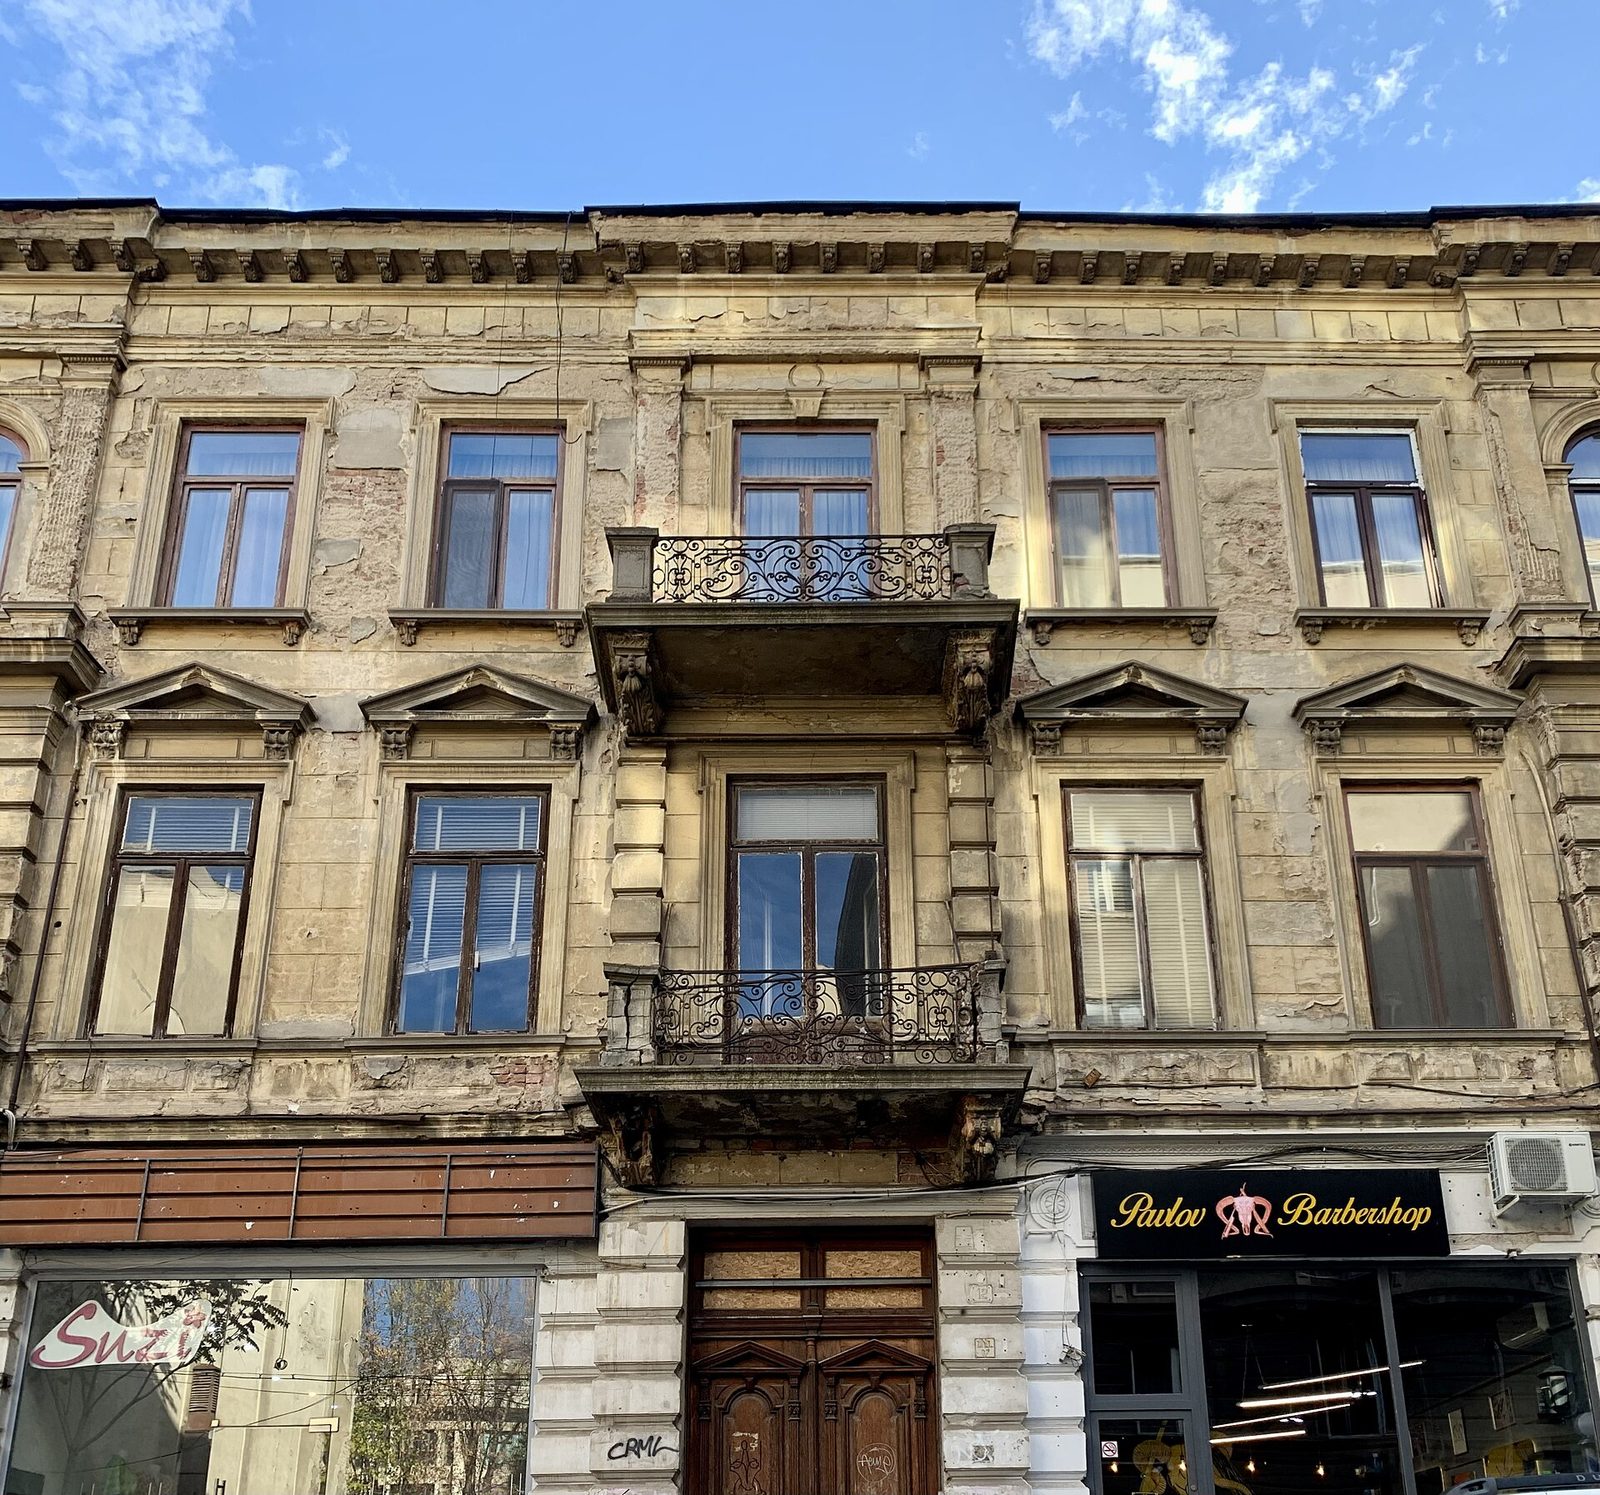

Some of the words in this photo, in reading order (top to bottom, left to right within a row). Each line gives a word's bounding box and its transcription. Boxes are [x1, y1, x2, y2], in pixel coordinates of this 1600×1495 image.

[1110, 1192, 1206, 1228] Pavlov
[1277, 1192, 1432, 1231] Barbershop
[30, 1302, 207, 1368] Suzi
